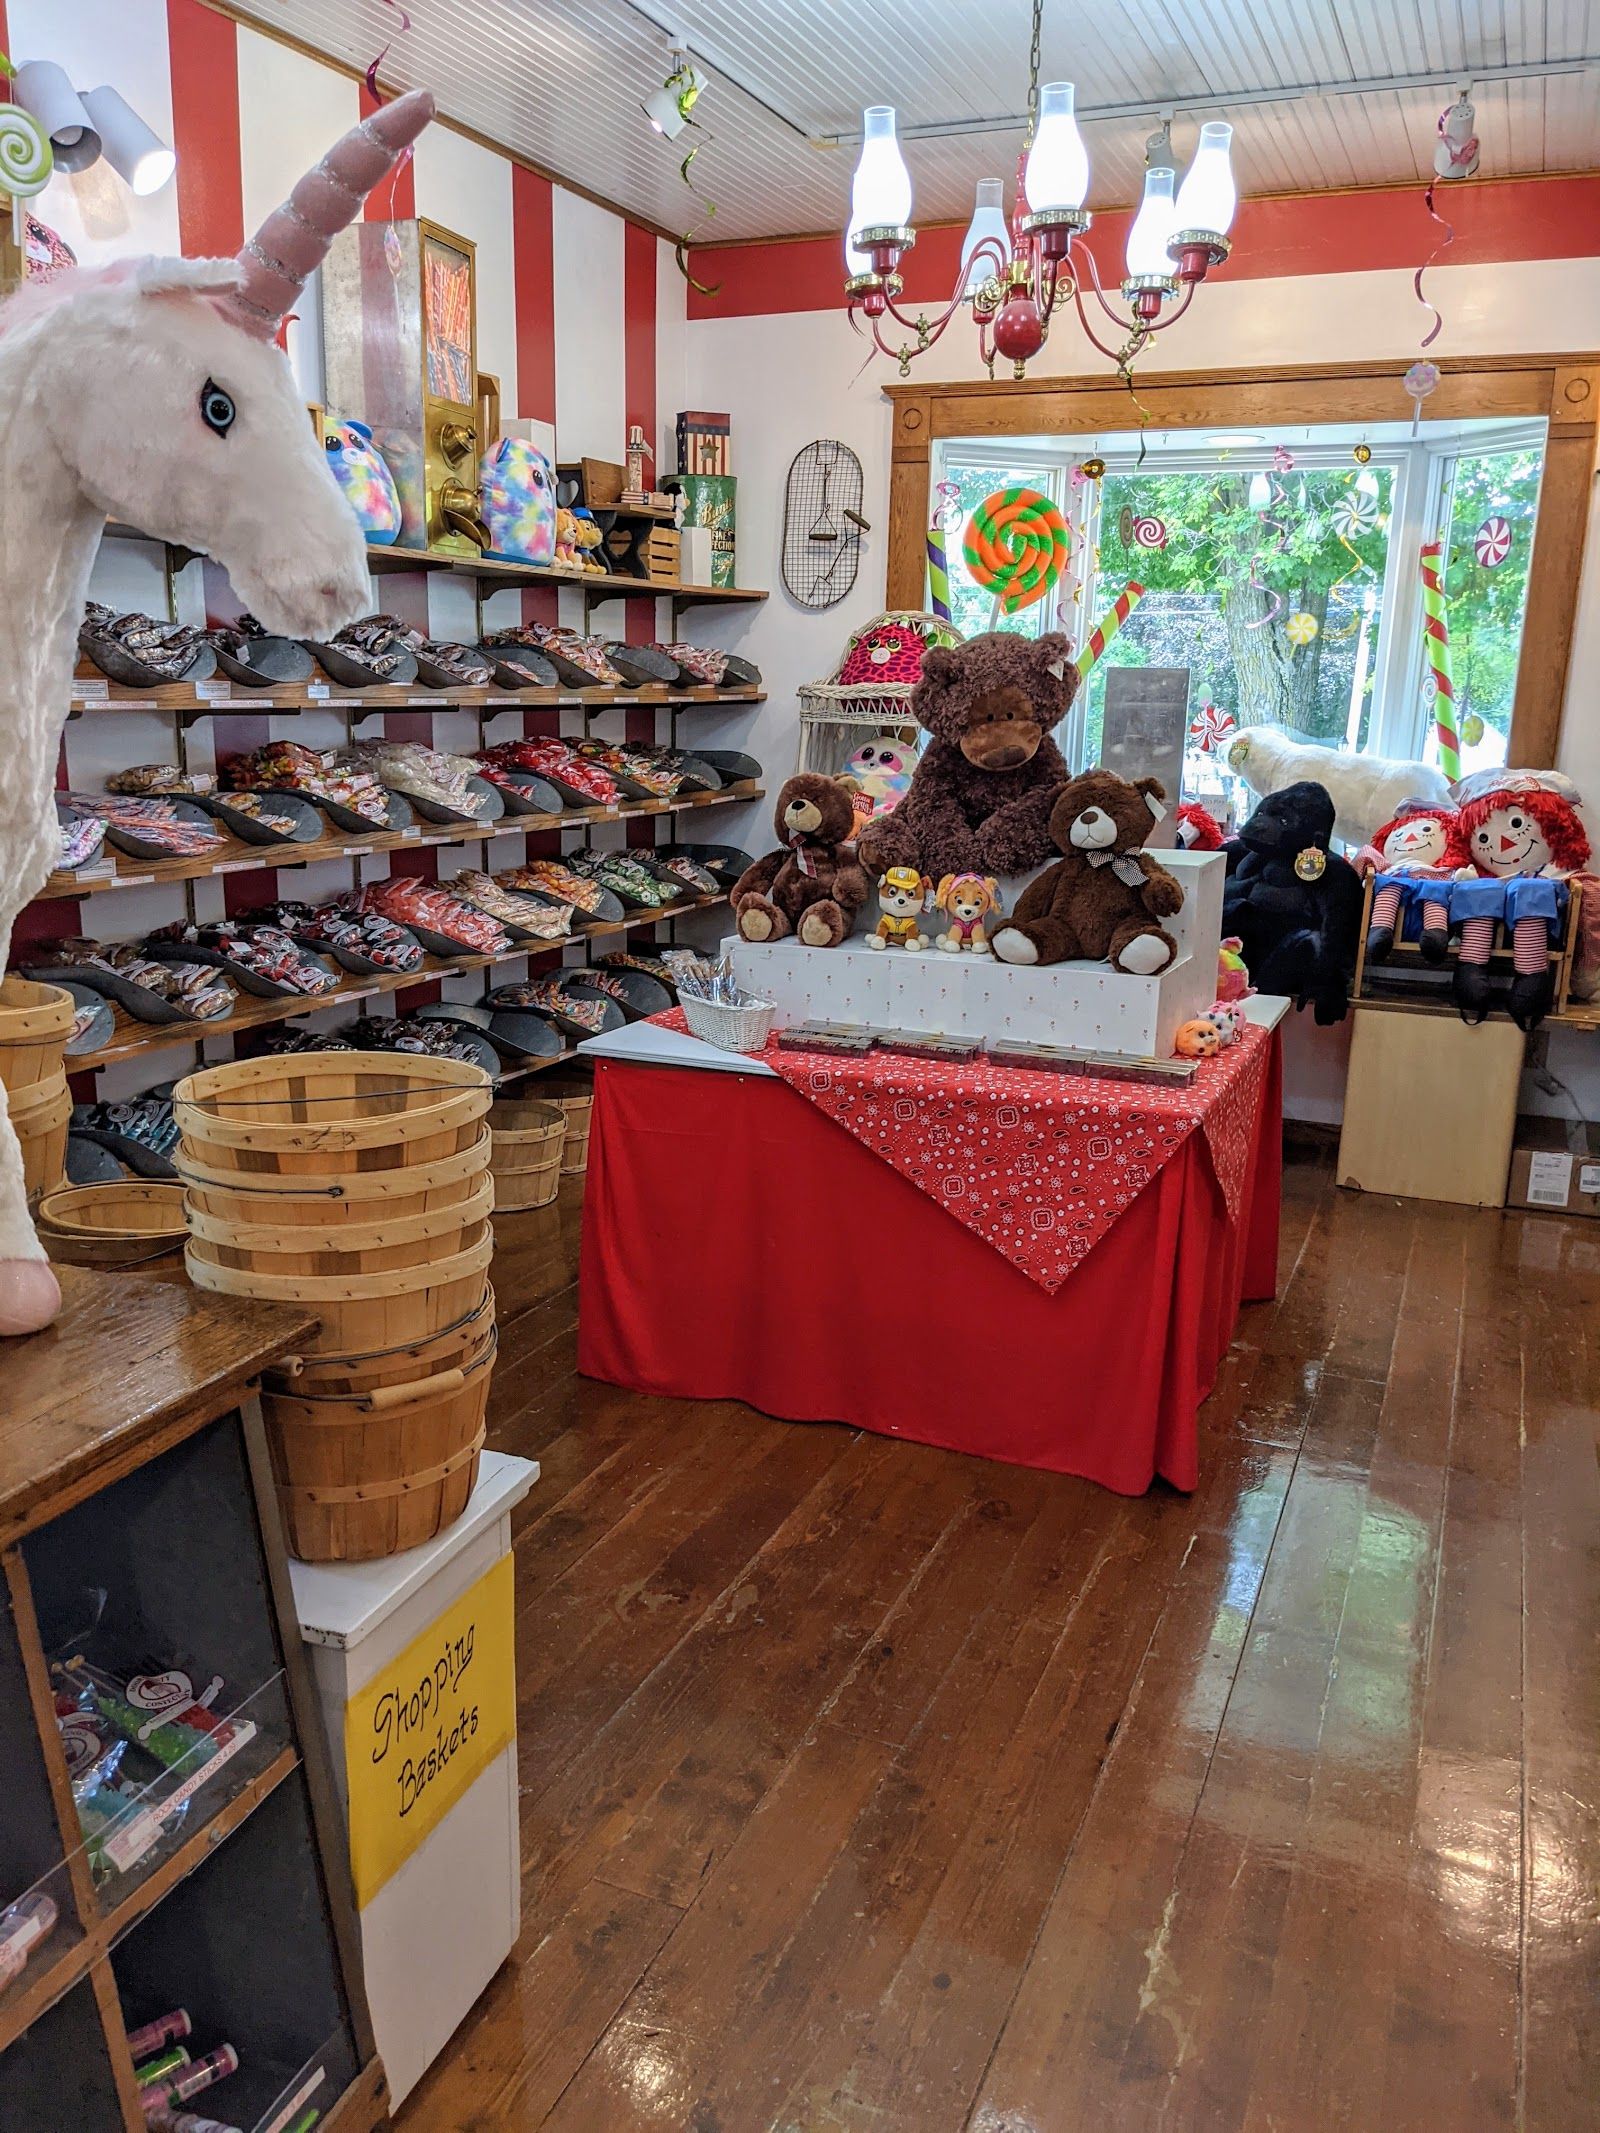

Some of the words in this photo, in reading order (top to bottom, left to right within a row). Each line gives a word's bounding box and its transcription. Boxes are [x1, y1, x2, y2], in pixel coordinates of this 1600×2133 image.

[371, 1622, 476, 1764] Shopping
[152, 1802, 172, 1822] ROCK
[174, 1780, 197, 1803] CANDY
[198, 1755, 222, 1781] STICKS
[396, 1704, 479, 1818] Baskets
